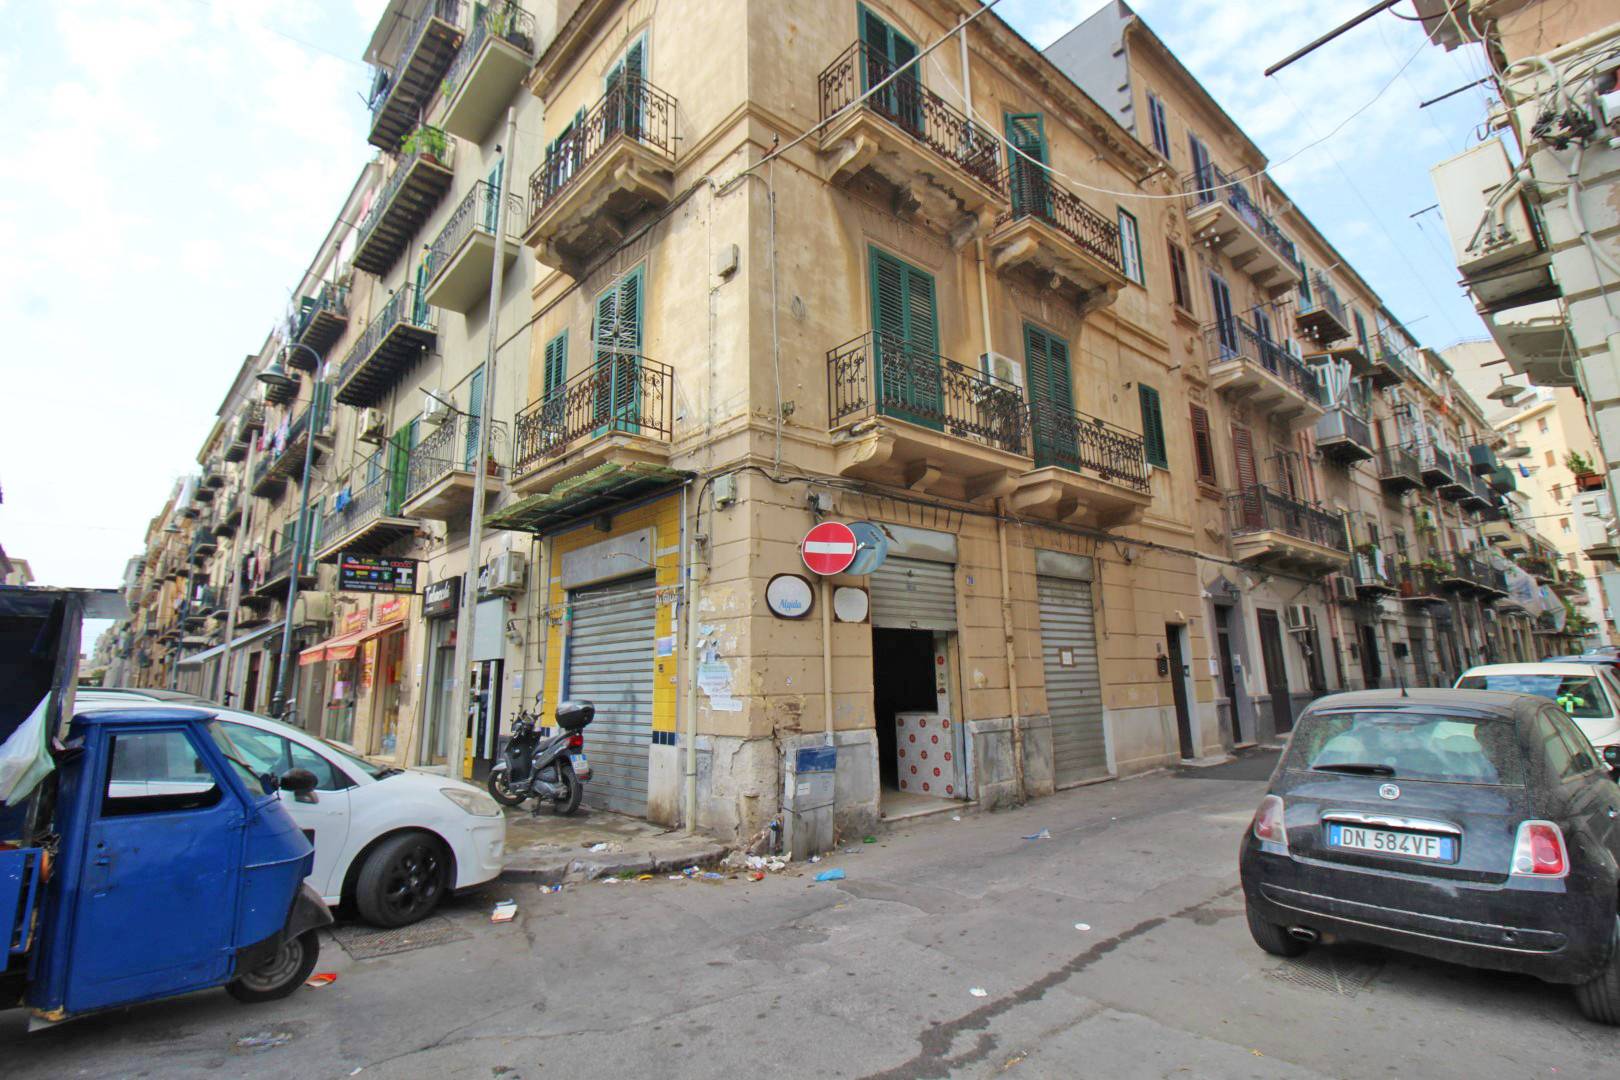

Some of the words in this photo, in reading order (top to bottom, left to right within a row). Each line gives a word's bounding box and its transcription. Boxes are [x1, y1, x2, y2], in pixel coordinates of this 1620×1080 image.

[778, 599, 801, 611] Algida
[1342, 828, 1366, 848] DN
[1374, 832, 1437, 856] 584VF
